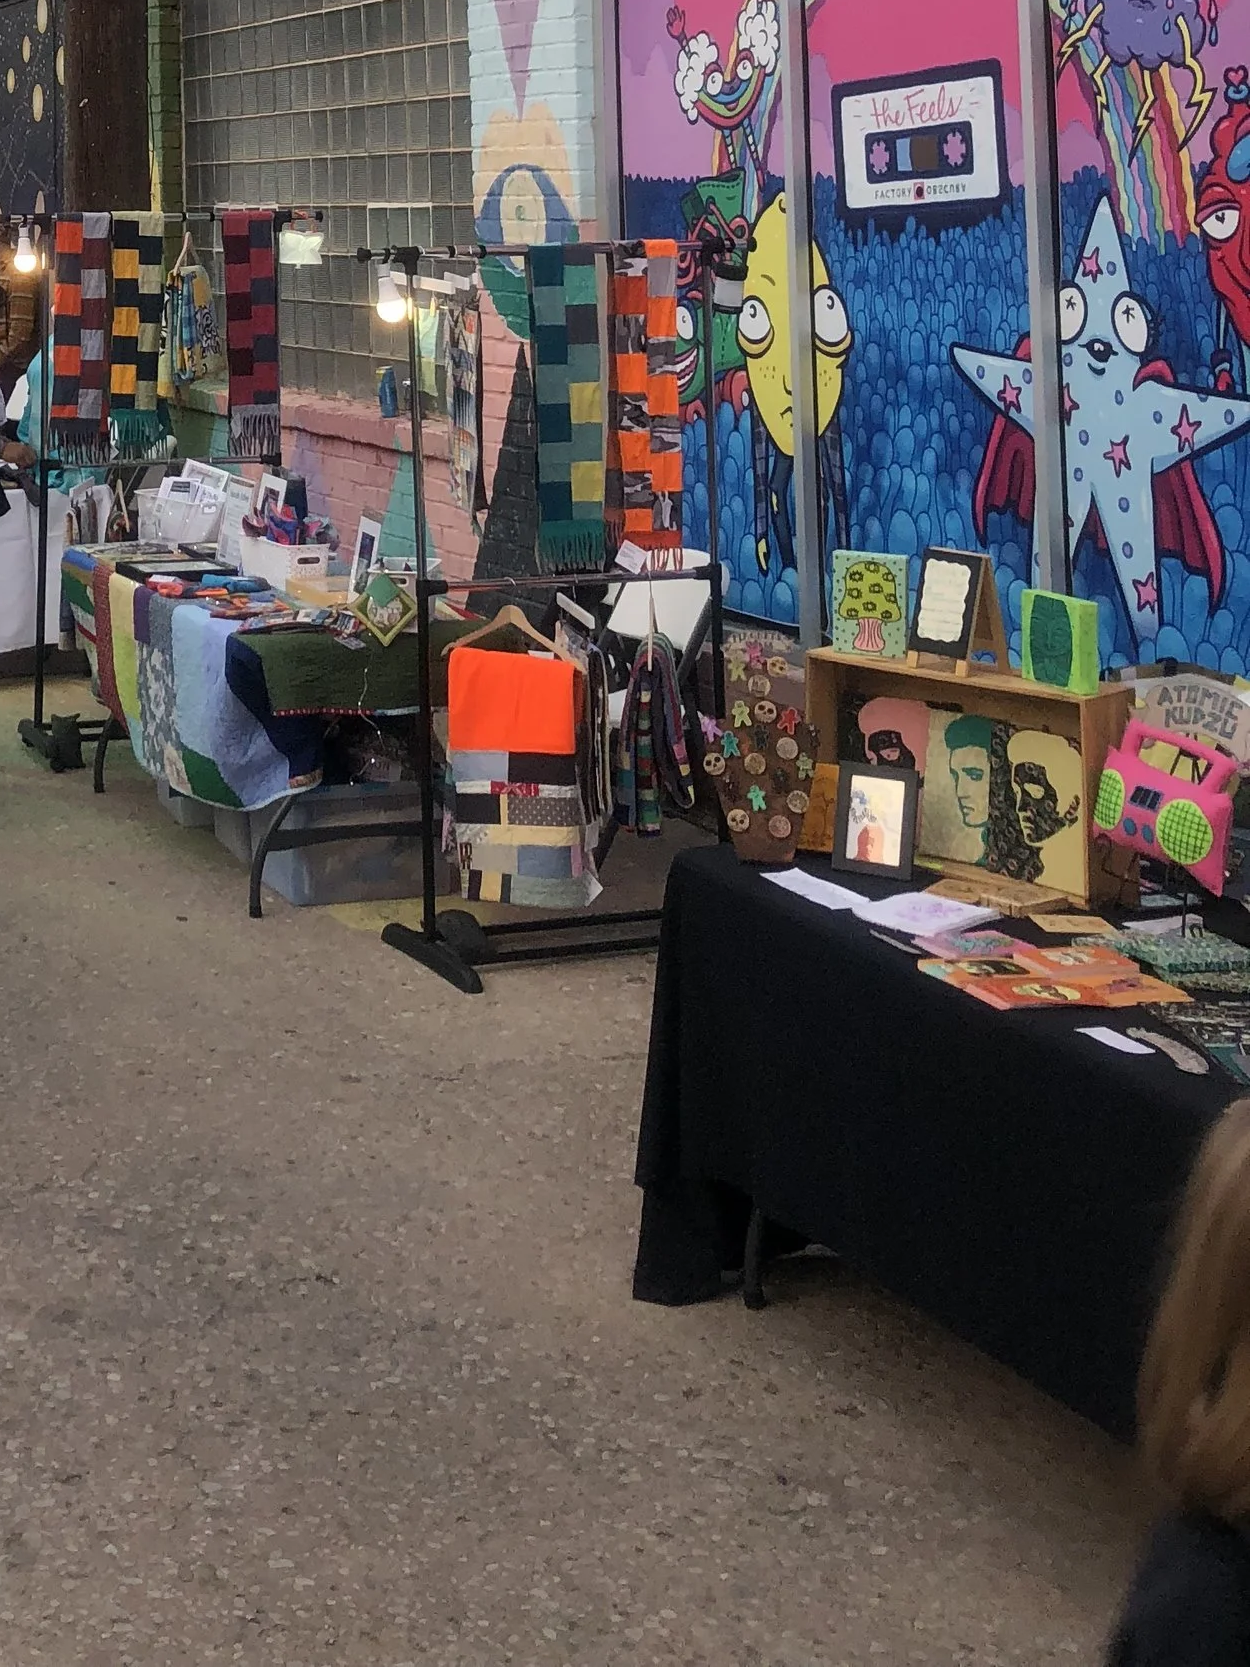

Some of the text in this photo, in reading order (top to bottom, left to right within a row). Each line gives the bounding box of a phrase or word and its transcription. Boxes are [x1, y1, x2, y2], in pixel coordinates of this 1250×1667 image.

[870, 84, 963, 129] the Feels
[874, 187, 912, 200] FACTORY
[1157, 685, 1243, 720] ATOMIC
